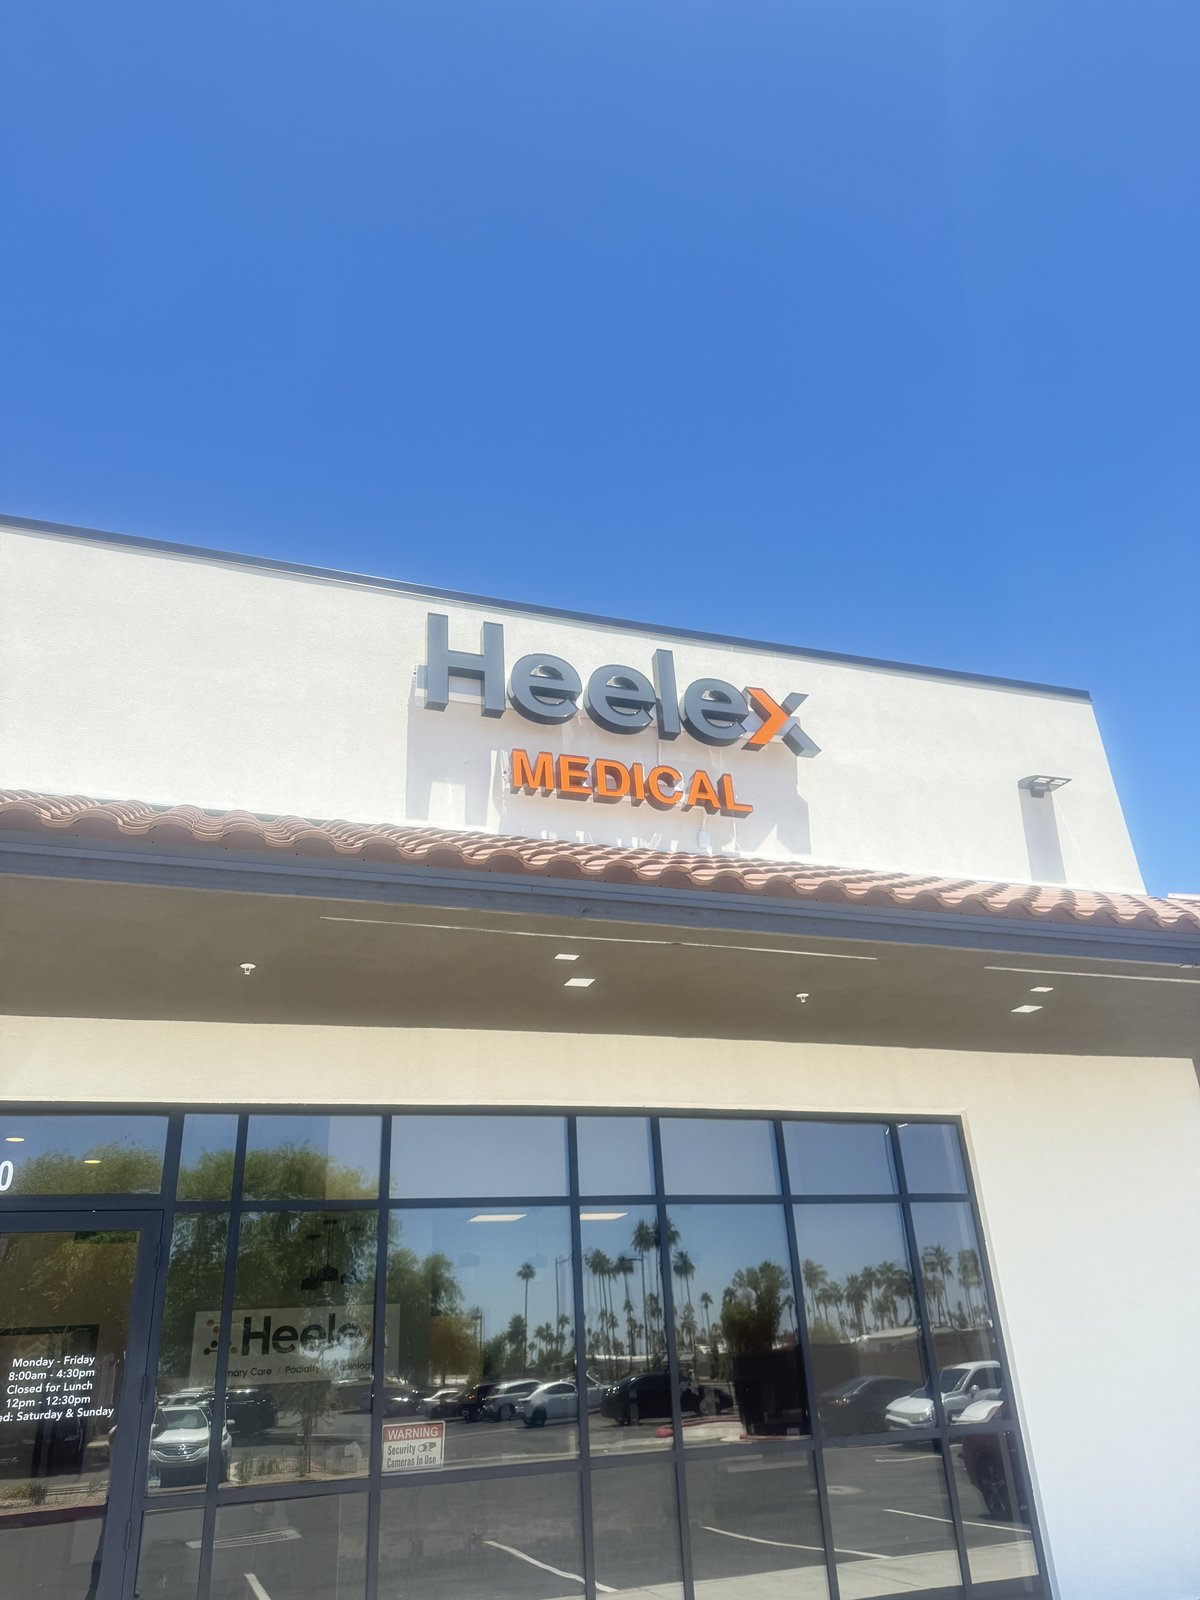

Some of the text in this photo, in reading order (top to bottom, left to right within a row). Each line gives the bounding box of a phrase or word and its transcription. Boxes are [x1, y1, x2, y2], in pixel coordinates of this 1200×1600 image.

[424, 612, 822, 758] Heelex
[509, 748, 753, 818] MEDICAL
[12, 1357, 54, 1368] Monday
[63, 1355, 95, 1366] Friday
[8, 1371, 47, 1381] 8:00am
[56, 1368, 95, 1379] 4:30pm
[250, 1367, 272, 1376] Care
[6, 1381, 93, 1395] Closed for Lunch
[6, 1399, 36, 1409] 12pm
[45, 1395, 91, 1406] 12:30pm
[0, 1406, 115, 1422] ed: Saturday & Sunday
[388, 1427, 439, 1441] WARNING
[387, 1443, 416, 1456] Security
[386, 1454, 437, 1468] Cameras In Use
